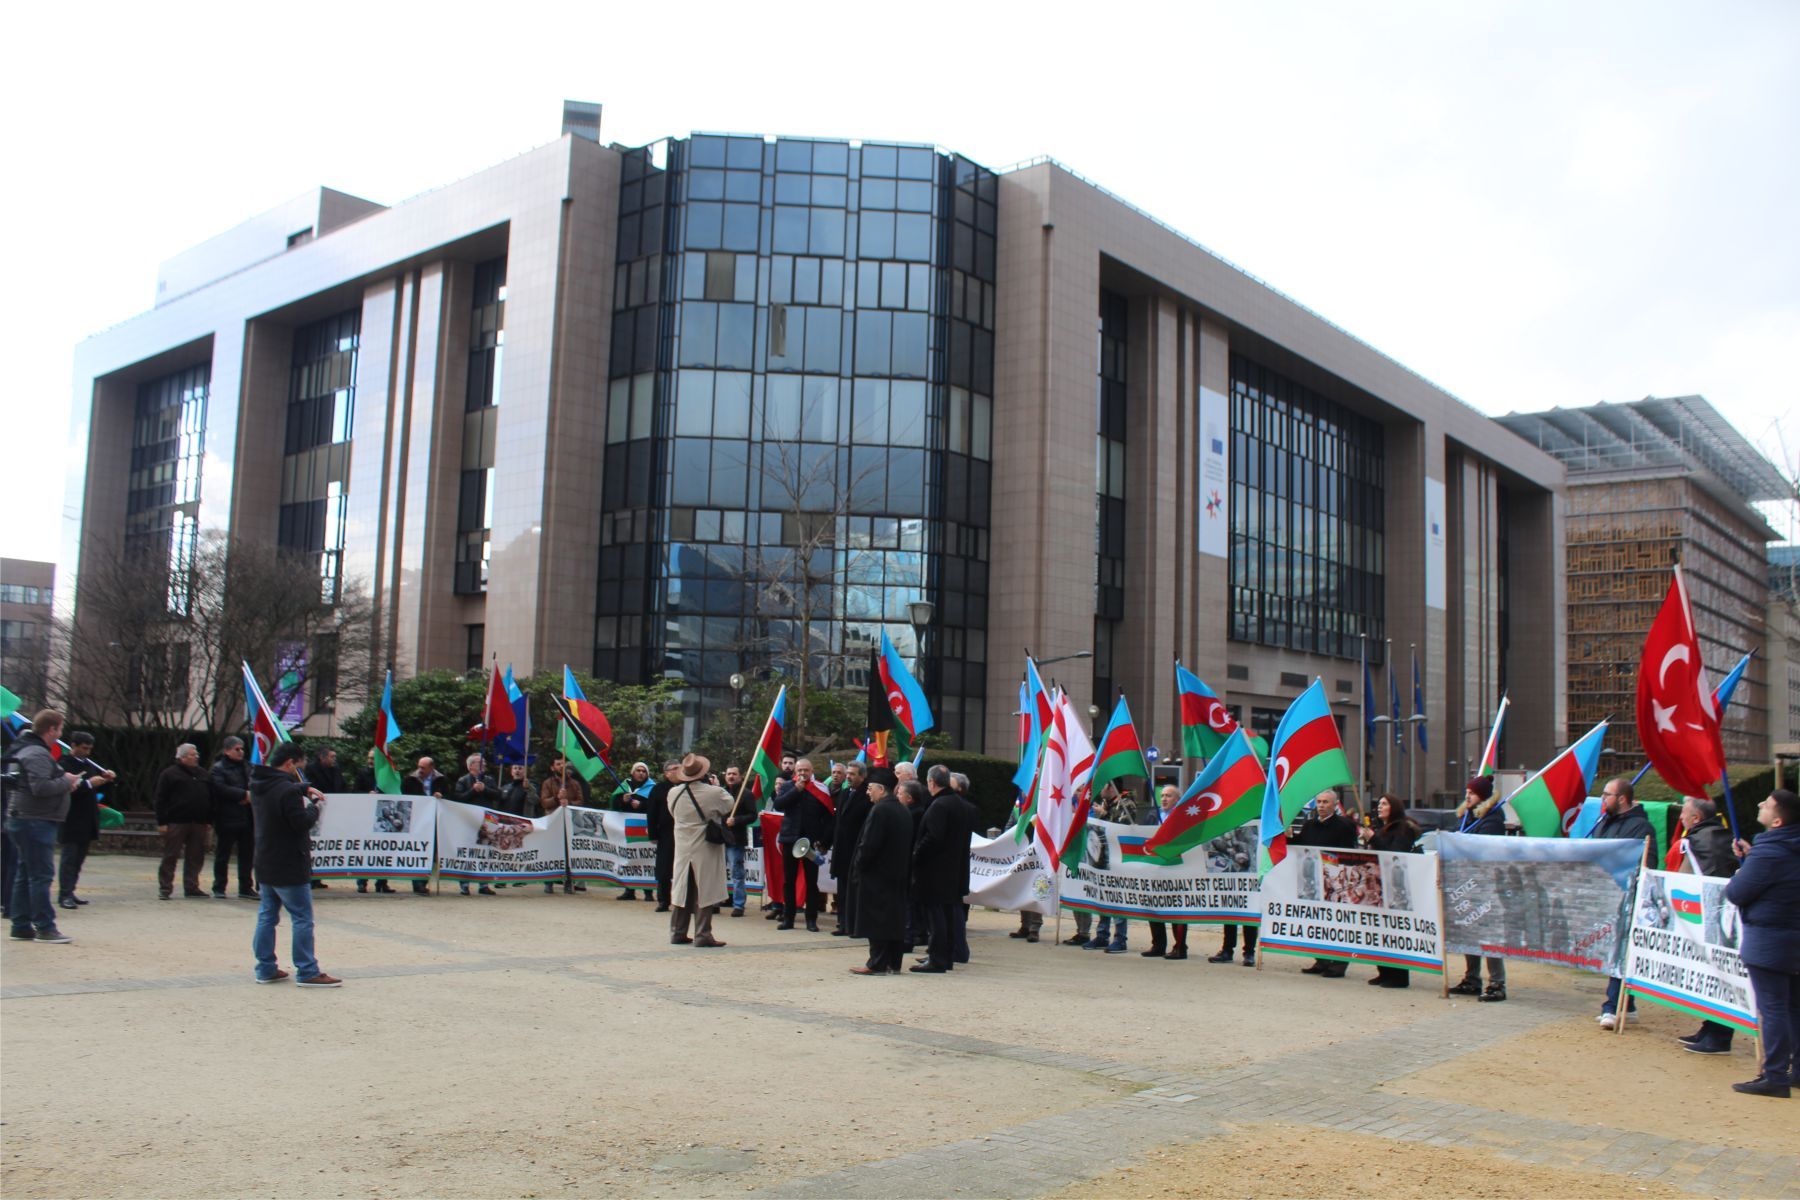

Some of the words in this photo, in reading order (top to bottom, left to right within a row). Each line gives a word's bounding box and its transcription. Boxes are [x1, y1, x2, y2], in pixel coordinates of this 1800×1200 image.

[345, 840, 361, 851] DE
[363, 840, 429, 851] KHODJALY
[572, 838, 591, 851] SERGE
[347, 856, 364, 867] EN
[367, 856, 392, 867] UNE
[396, 857, 428, 867] NUIT
[457, 847, 467, 858] WE
[468, 848, 485, 859] WILL
[488, 849, 515, 861] NEVER
[515, 850, 539, 862] FORGET
[445, 859, 477, 871] VICTIMS
[478, 861, 489, 872] OF
[524, 860, 565, 872] MASSACRE
[1098, 875, 1105, 886] LE
[1106, 875, 1139, 890] GENOCIDE
[1140, 879, 1150, 892] DE
[1151, 879, 1192, 892] KHODJALY
[1195, 878, 1210, 891] EST
[1213, 878, 1236, 891] CELUI
[1238, 878, 1247, 891] DE
[1100, 890, 1105, 901] A
[1105, 890, 1124, 904] TOUS
[1124, 891, 1137, 904] LES
[1139, 893, 1183, 908] GENOCIDES
[1184, 895, 1207, 907] DANS
[1208, 895, 1219, 907] LE
[1221, 895, 1248, 908] MONDE
[1268, 902, 1282, 916] 83
[1285, 904, 1333, 922] ENFANTS
[1335, 909, 1356, 925] ONT
[1360, 912, 1380, 927] ETE
[1382, 914, 1411, 931] TUES
[1414, 918, 1437, 936] LORS
[1272, 922, 1287, 935] DE
[1290, 923, 1304, 938] LA
[1307, 925, 1361, 944] GENOCIDE
[1365, 931, 1379, 946] DE
[1382, 934, 1436, 955] KHODJALY
[1632, 927, 1672, 954] GENOCIDE
[1672, 936, 1682, 956] DE
[1635, 956, 1650, 978] PAR
[1685, 968, 1695, 991] LE
